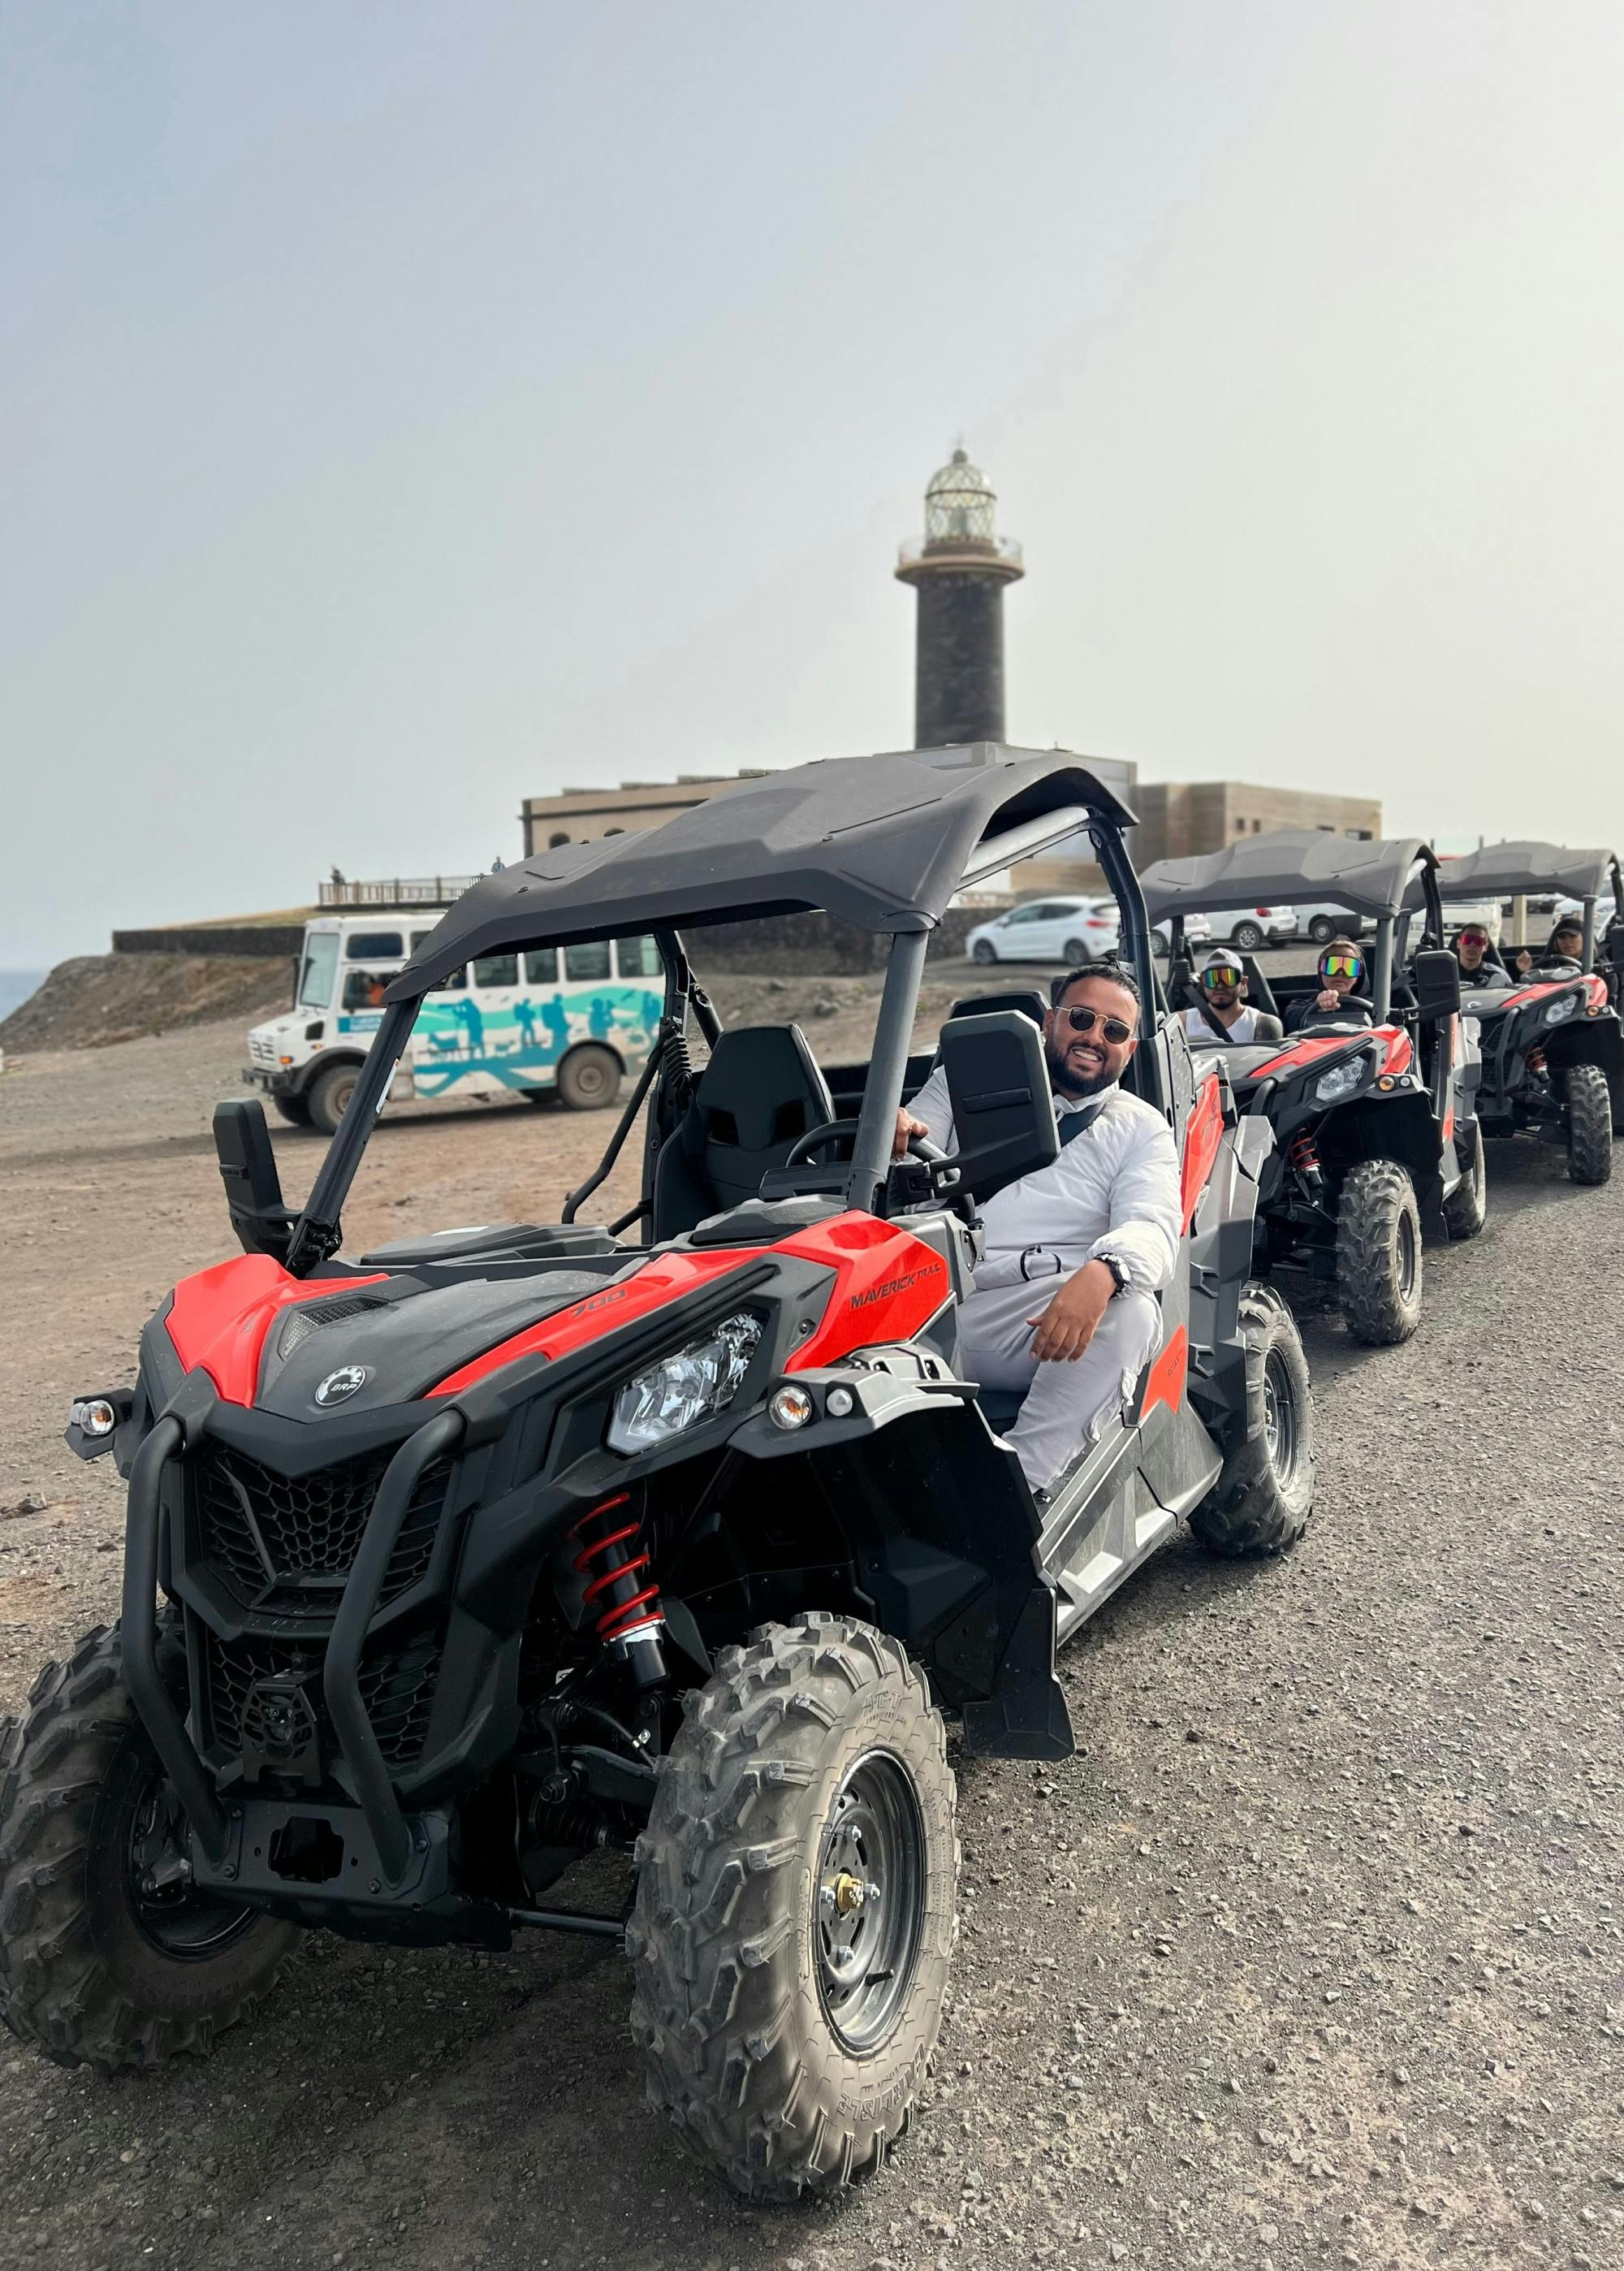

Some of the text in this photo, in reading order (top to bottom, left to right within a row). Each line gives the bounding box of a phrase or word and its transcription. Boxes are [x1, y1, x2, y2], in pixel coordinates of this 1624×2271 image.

[570, 1289, 626, 1319] 700
[850, 1263, 941, 1309] MAVERICK TRAIL
[330, 1383, 358, 1391] BRP
[836, 2042, 926, 2122] CARLISLE
